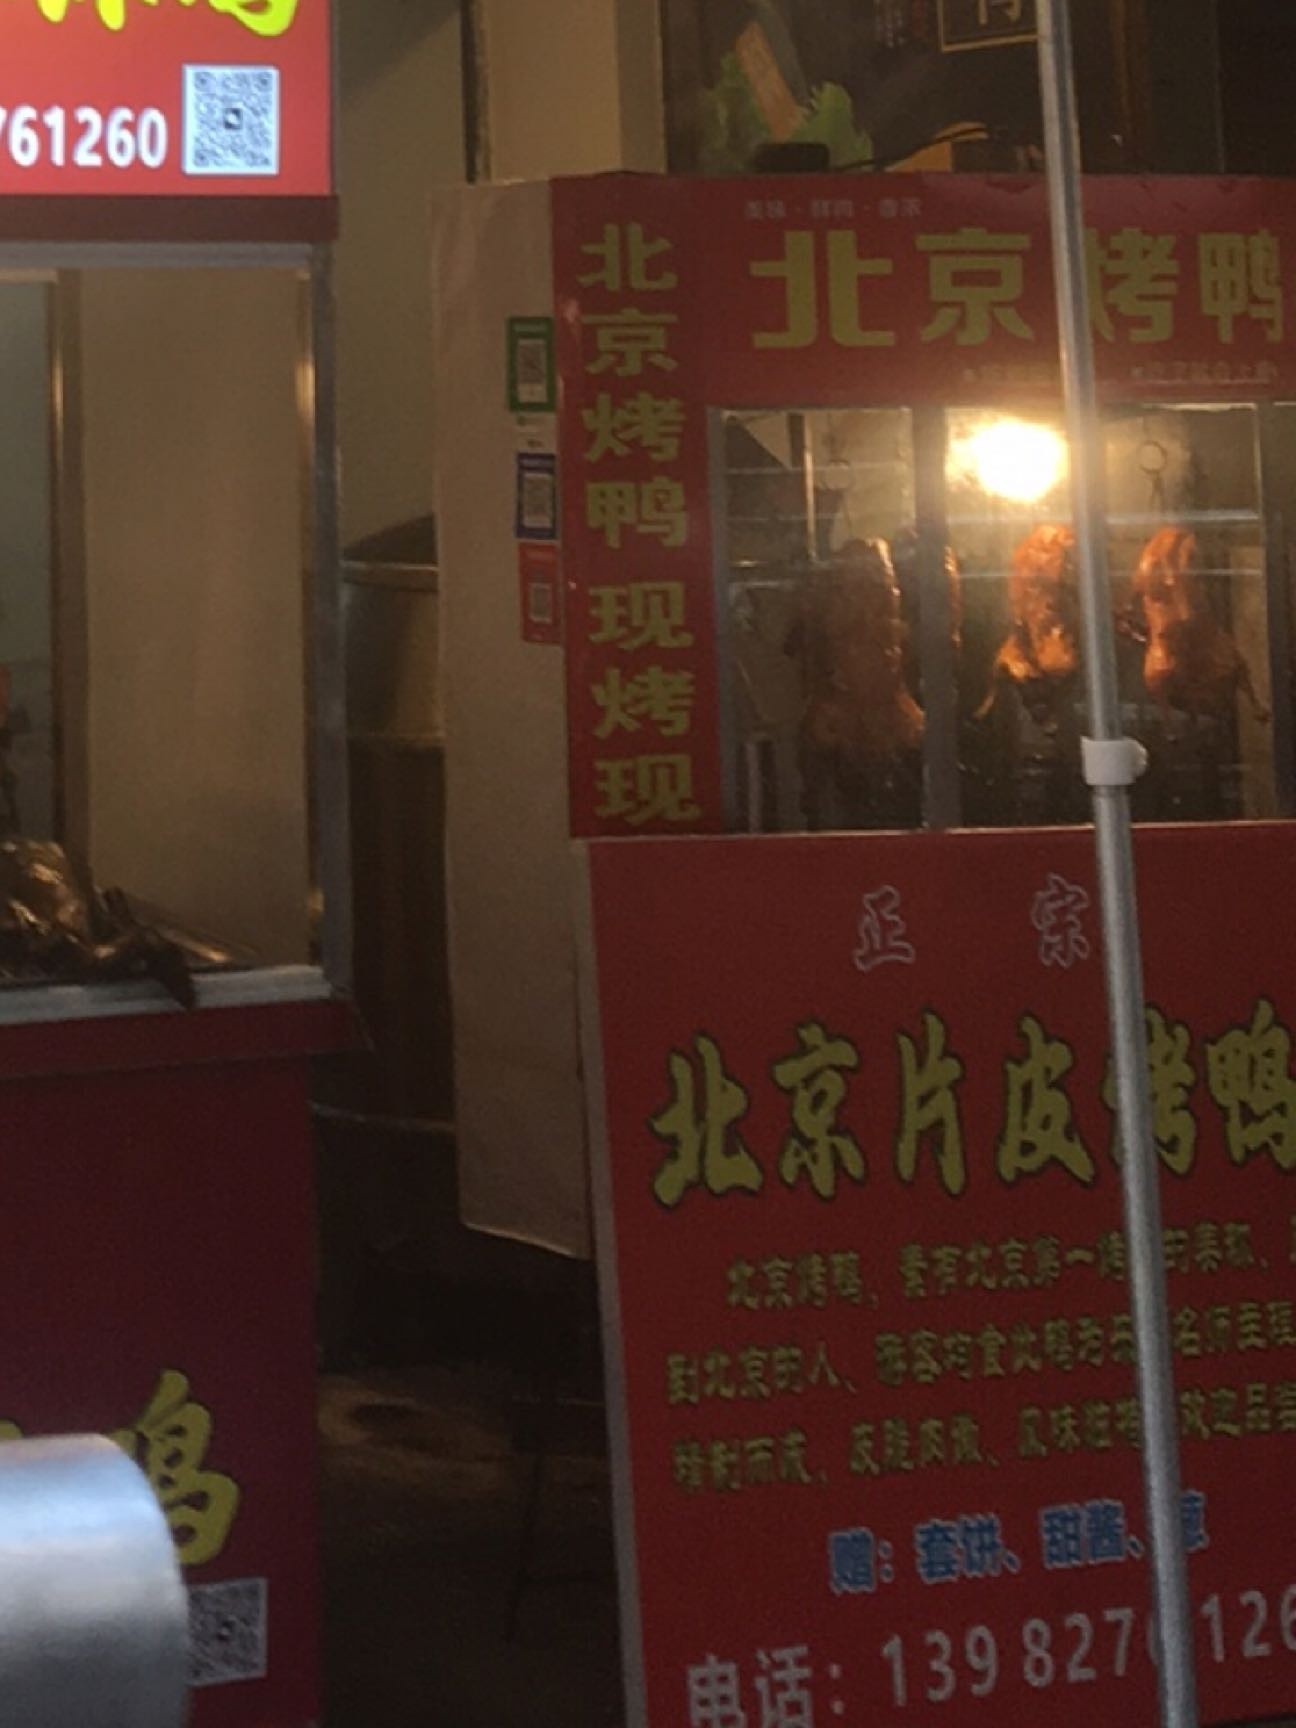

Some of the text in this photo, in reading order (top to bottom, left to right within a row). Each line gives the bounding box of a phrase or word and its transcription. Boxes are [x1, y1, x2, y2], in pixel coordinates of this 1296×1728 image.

[749, 226, 1283, 350] 北京烤鸭
[649, 998, 1296, 1208] 北京片皮烤鸭
